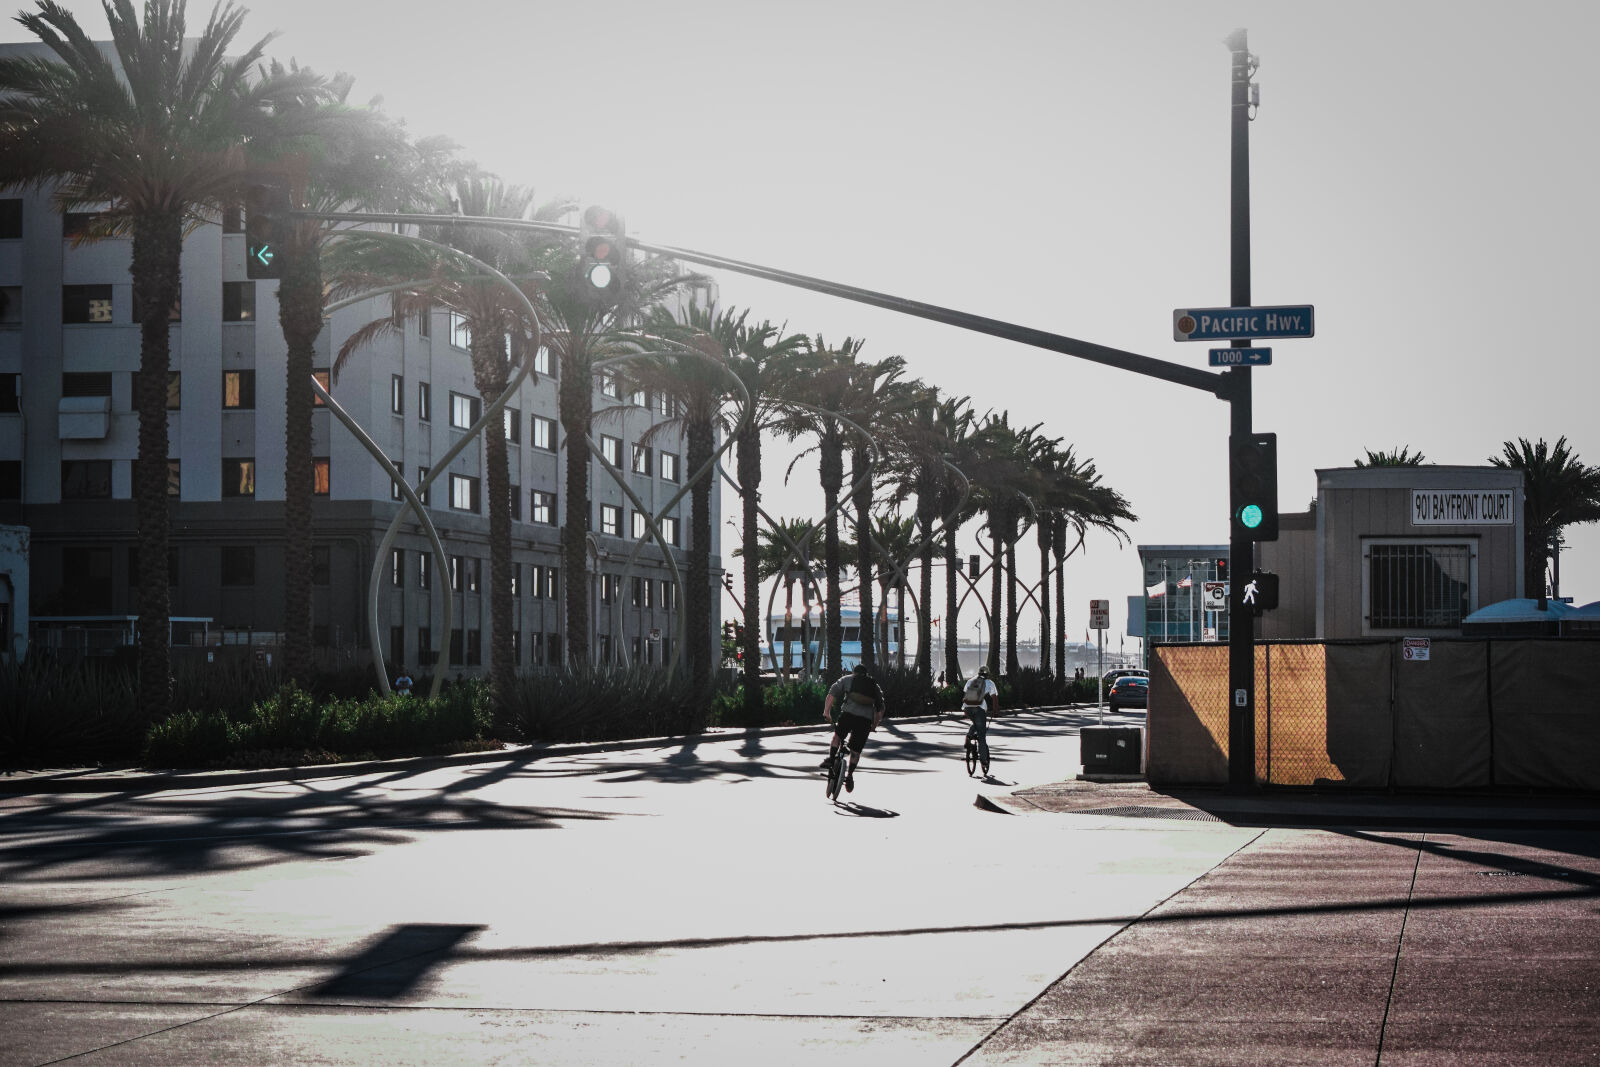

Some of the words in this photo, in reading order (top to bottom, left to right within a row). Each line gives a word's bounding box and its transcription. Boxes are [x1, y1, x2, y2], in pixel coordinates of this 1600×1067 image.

[1201, 315, 1258, 332] PACIFIC
[1265, 313, 1305, 332] HWY.
[1217, 351, 1242, 363] 1000
[1415, 494, 1430, 520] 901
[1433, 493, 1479, 520] BAYFRONT
[1482, 493, 1510, 520] COURT
